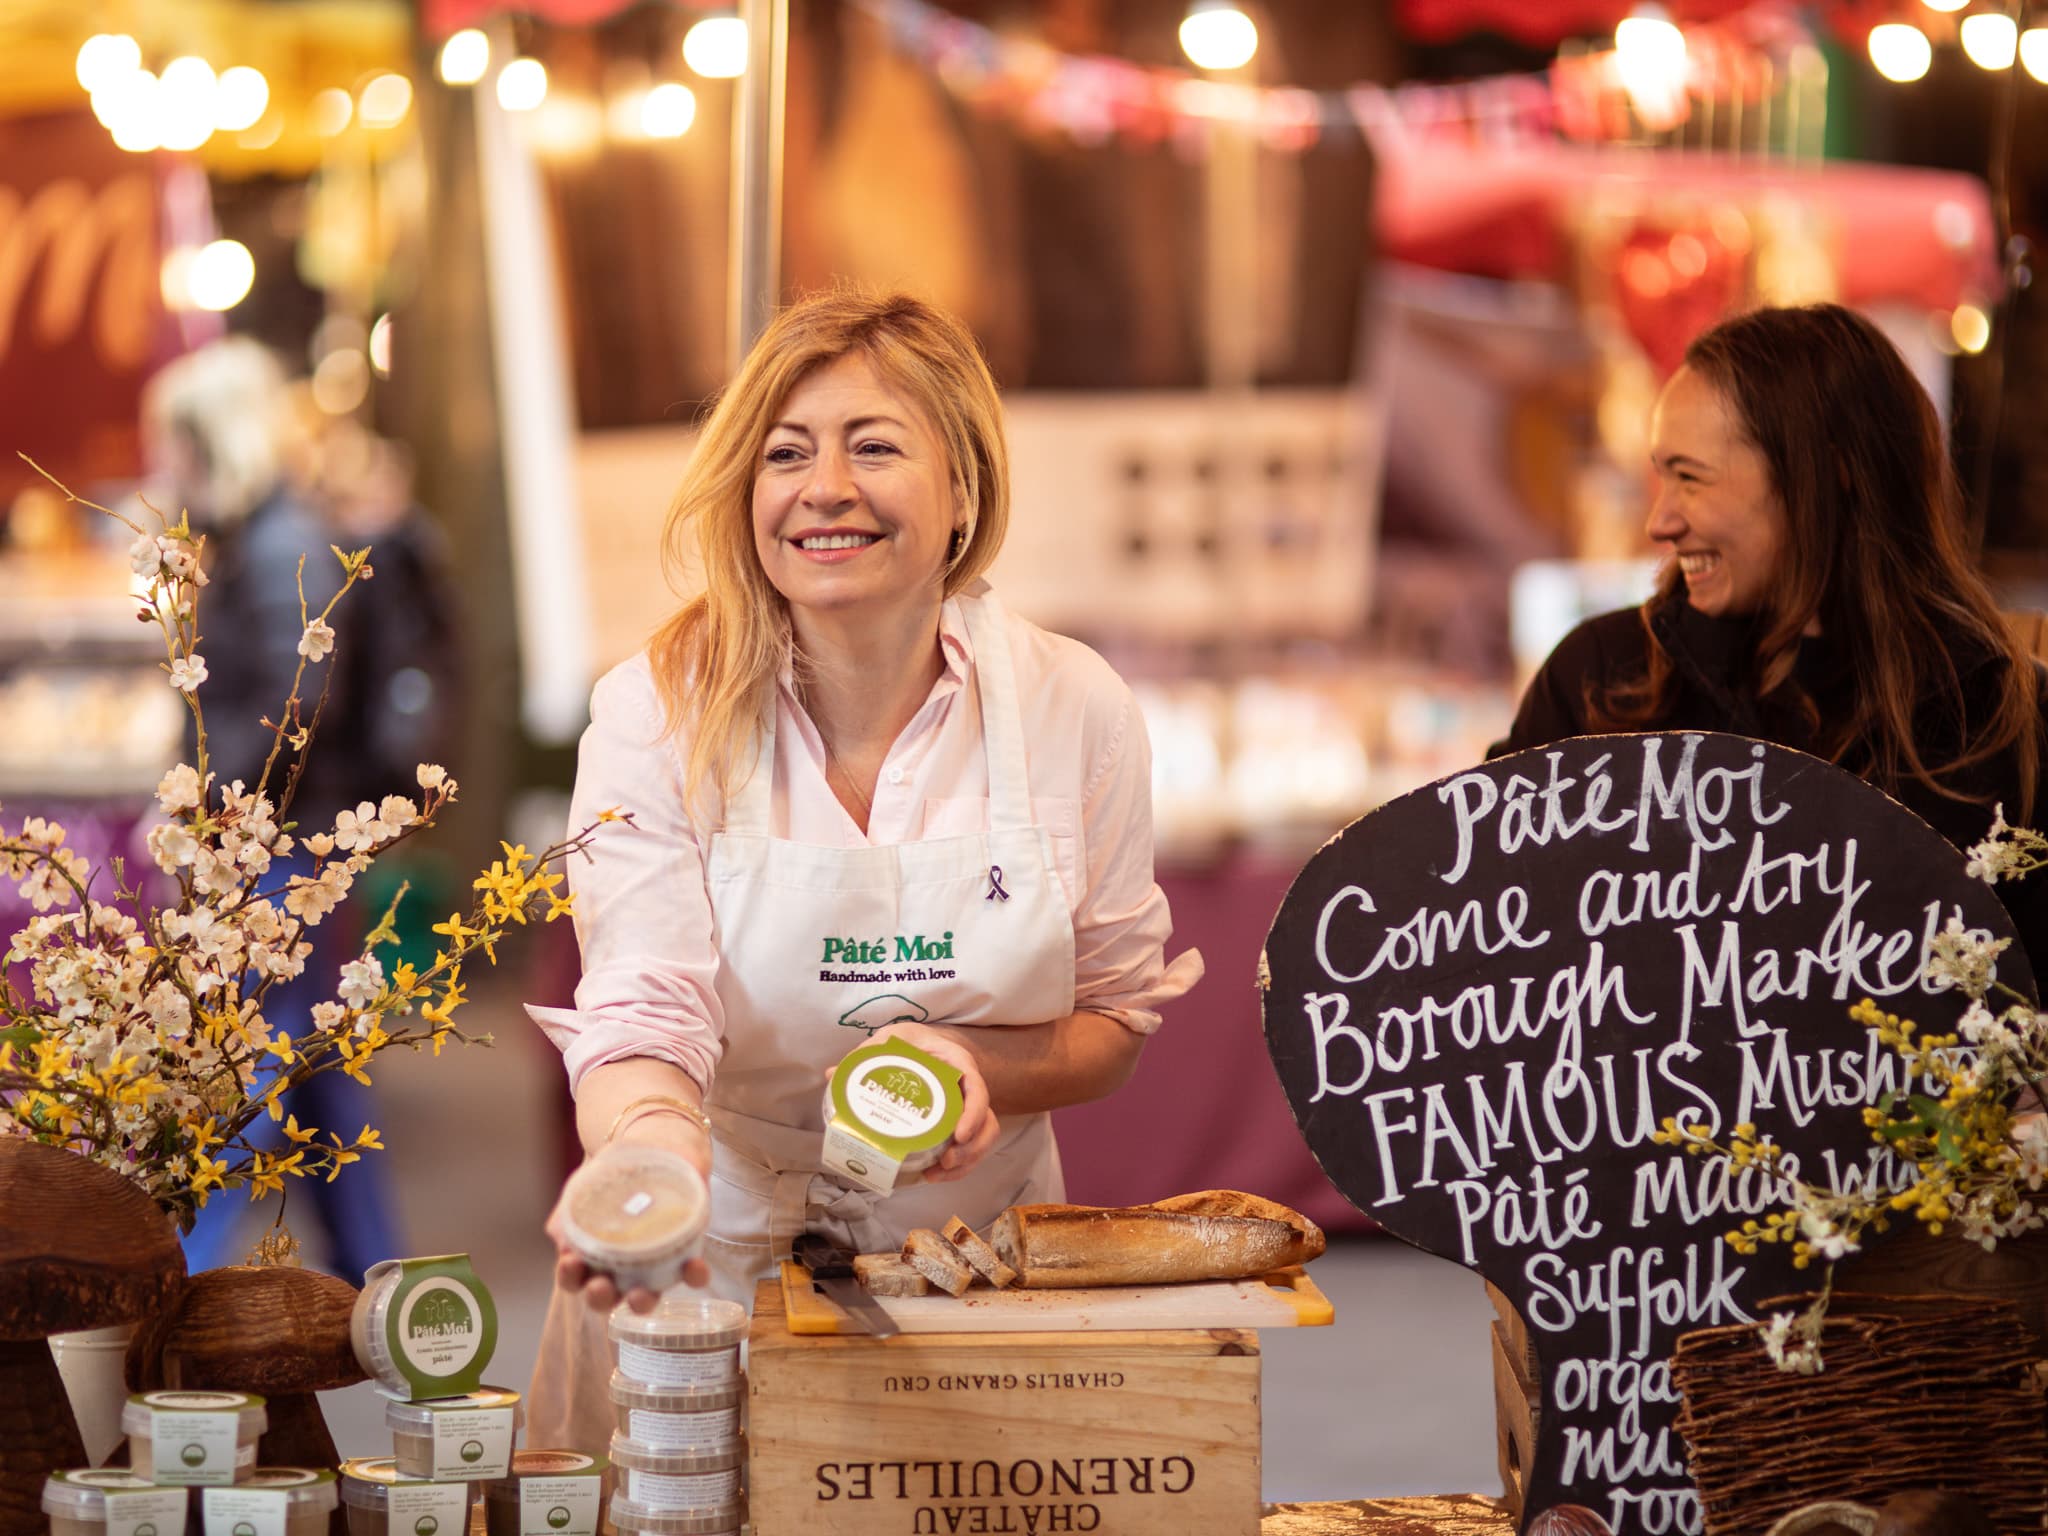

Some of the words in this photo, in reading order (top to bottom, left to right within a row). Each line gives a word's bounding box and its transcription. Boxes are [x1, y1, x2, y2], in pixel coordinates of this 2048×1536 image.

[1437, 751, 1637, 884] Pâté
[1629, 734, 1792, 852] Moi
[1315, 885, 1550, 983] Come
[1579, 840, 1722, 936] and
[1728, 831, 1872, 974] try
[820, 936, 887, 964] Pâté
[893, 931, 955, 963] Moi
[819, 970, 892, 983] Handmade
[894, 968, 927, 982] with
[929, 967, 956, 980] love
[1303, 941, 1657, 1103] Borough
[1363, 1042, 1721, 1206] FAMOUS
[1445, 1165, 1603, 1264] Pâté
[1524, 1235, 1758, 1363] Suffolk
[413, 1323, 441, 1338] Pâté
[442, 1320, 468, 1336] Moi
[883, 1375, 931, 1393] CRU
[937, 1373, 1018, 1391] GRAND
[1026, 1372, 1125, 1389] CHABLIS
[815, 1456, 1196, 1501] GRENOUILLES
